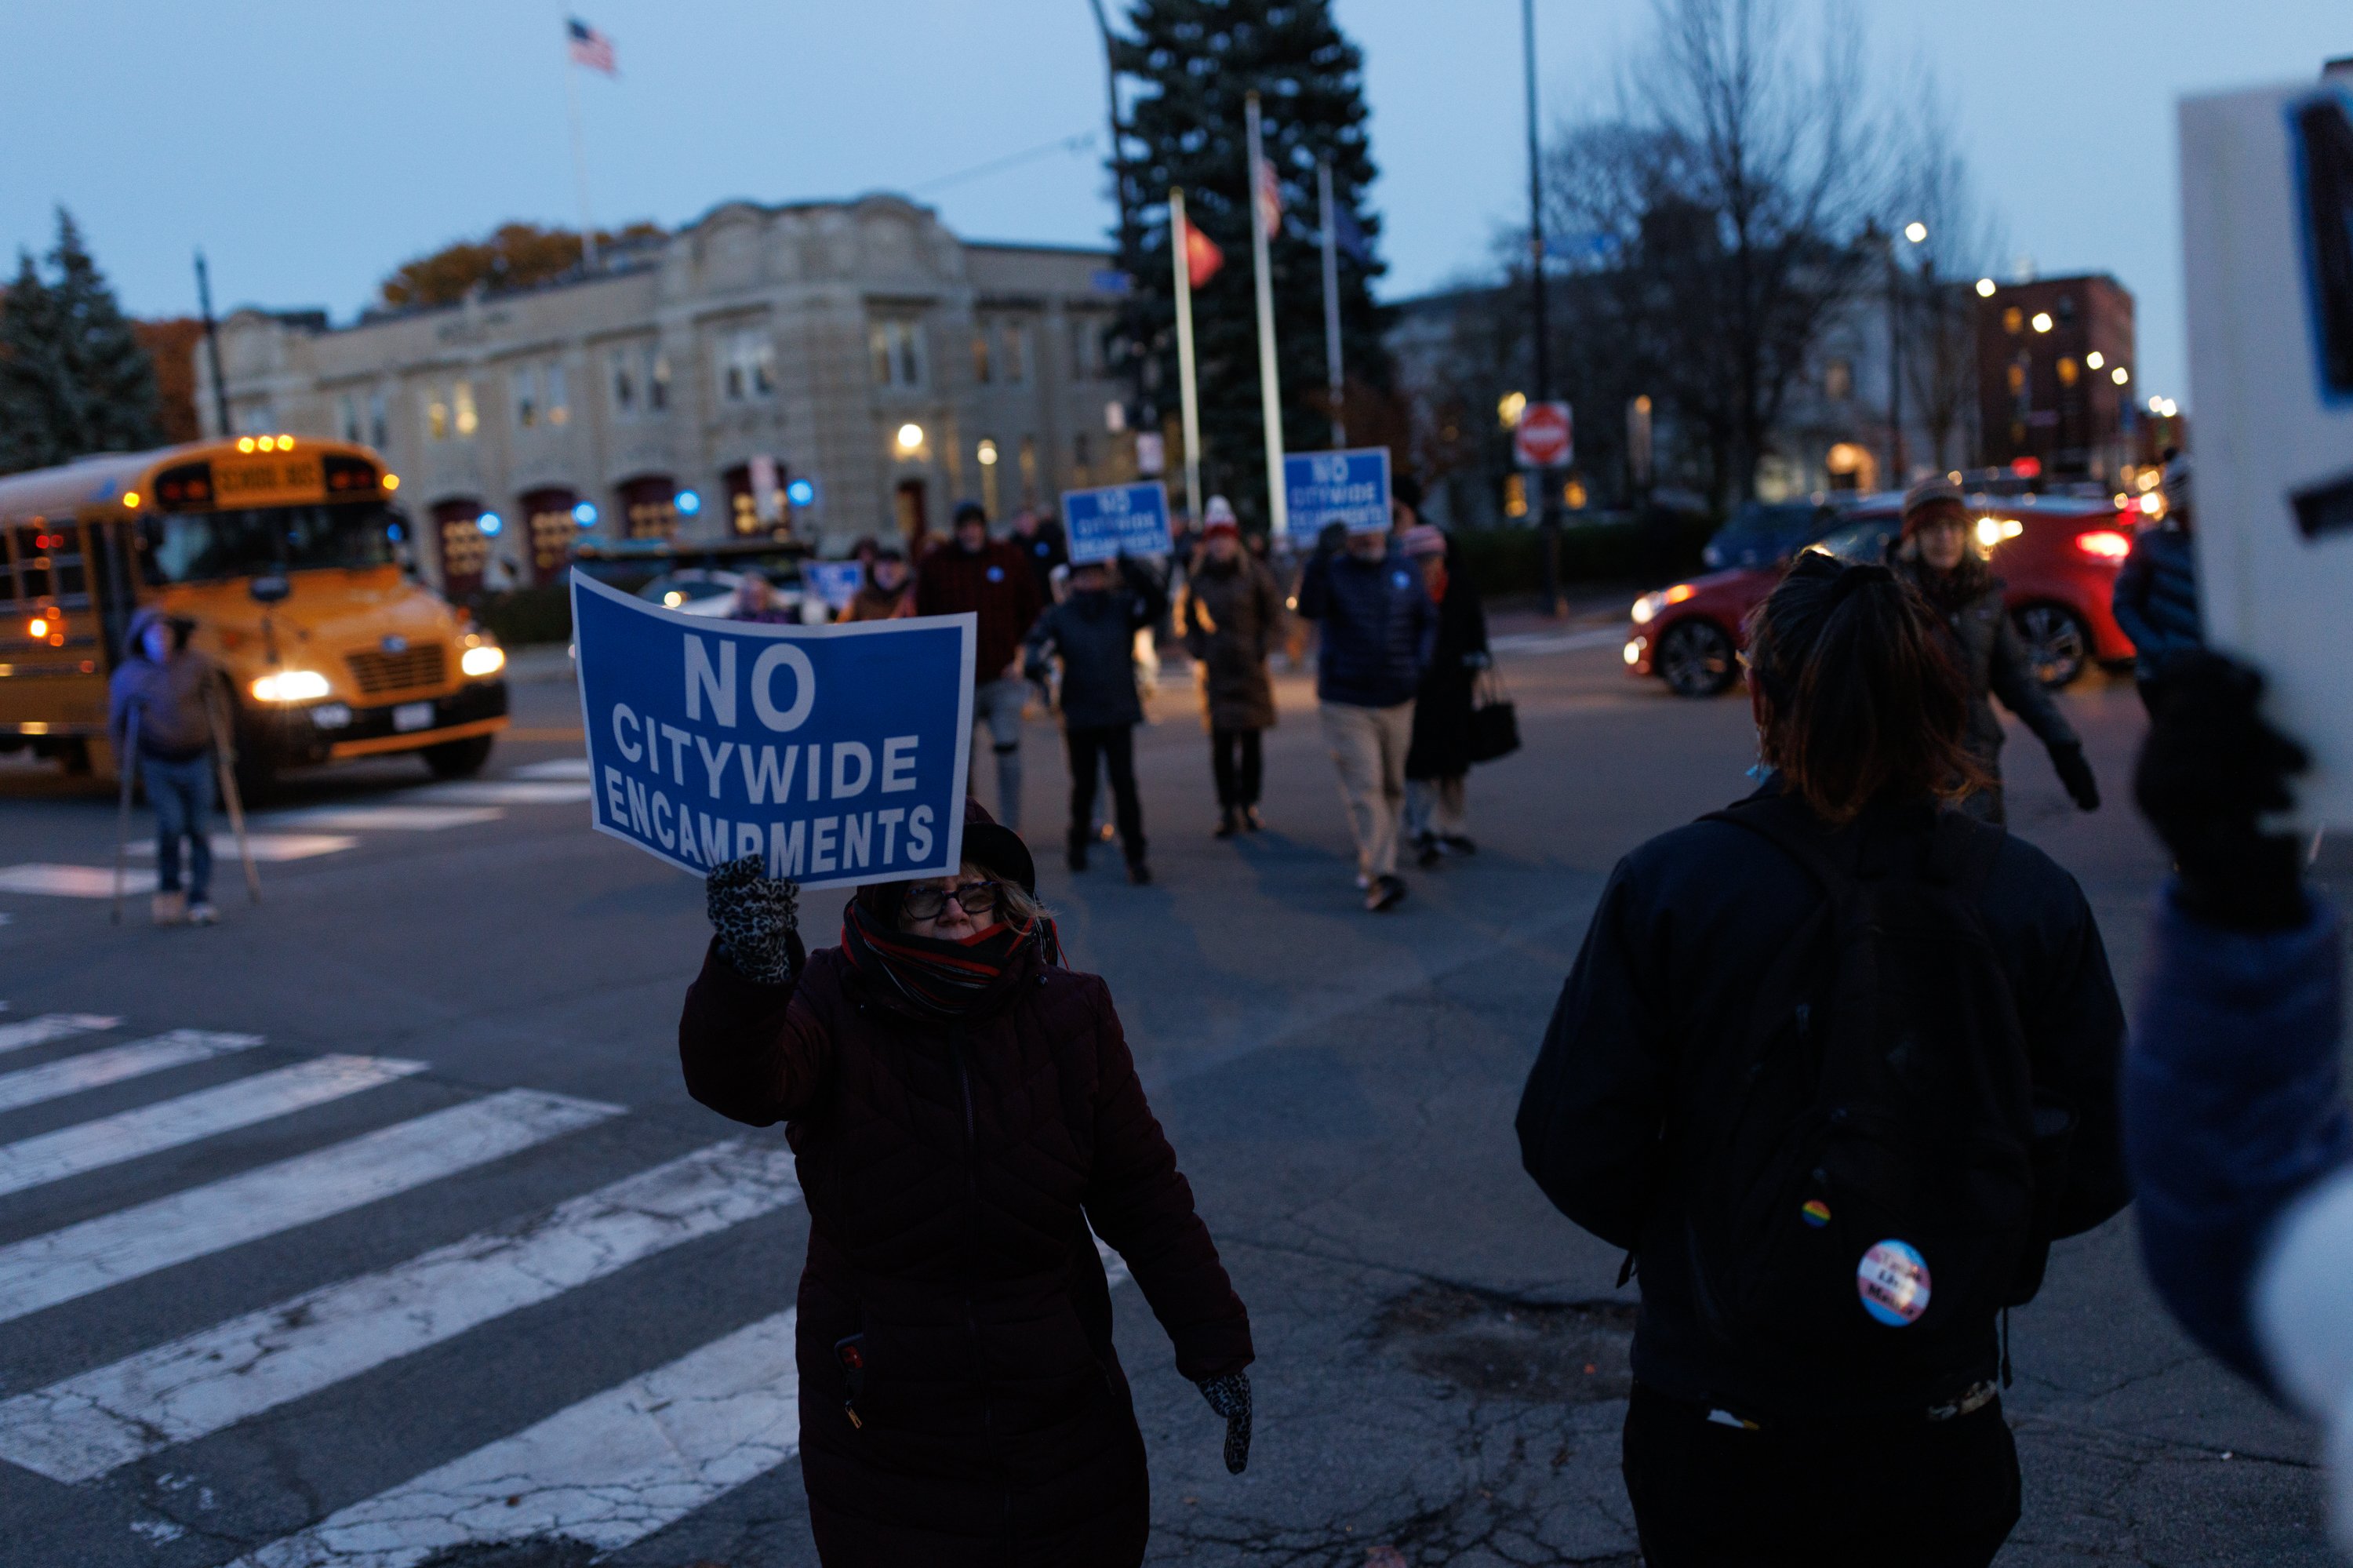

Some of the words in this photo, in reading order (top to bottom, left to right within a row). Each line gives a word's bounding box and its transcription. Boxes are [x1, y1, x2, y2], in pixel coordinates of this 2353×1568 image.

[683, 633, 816, 732] NO
[612, 703, 918, 805] CITYWIDE
[604, 765, 934, 879] ENCAMPMENTS
